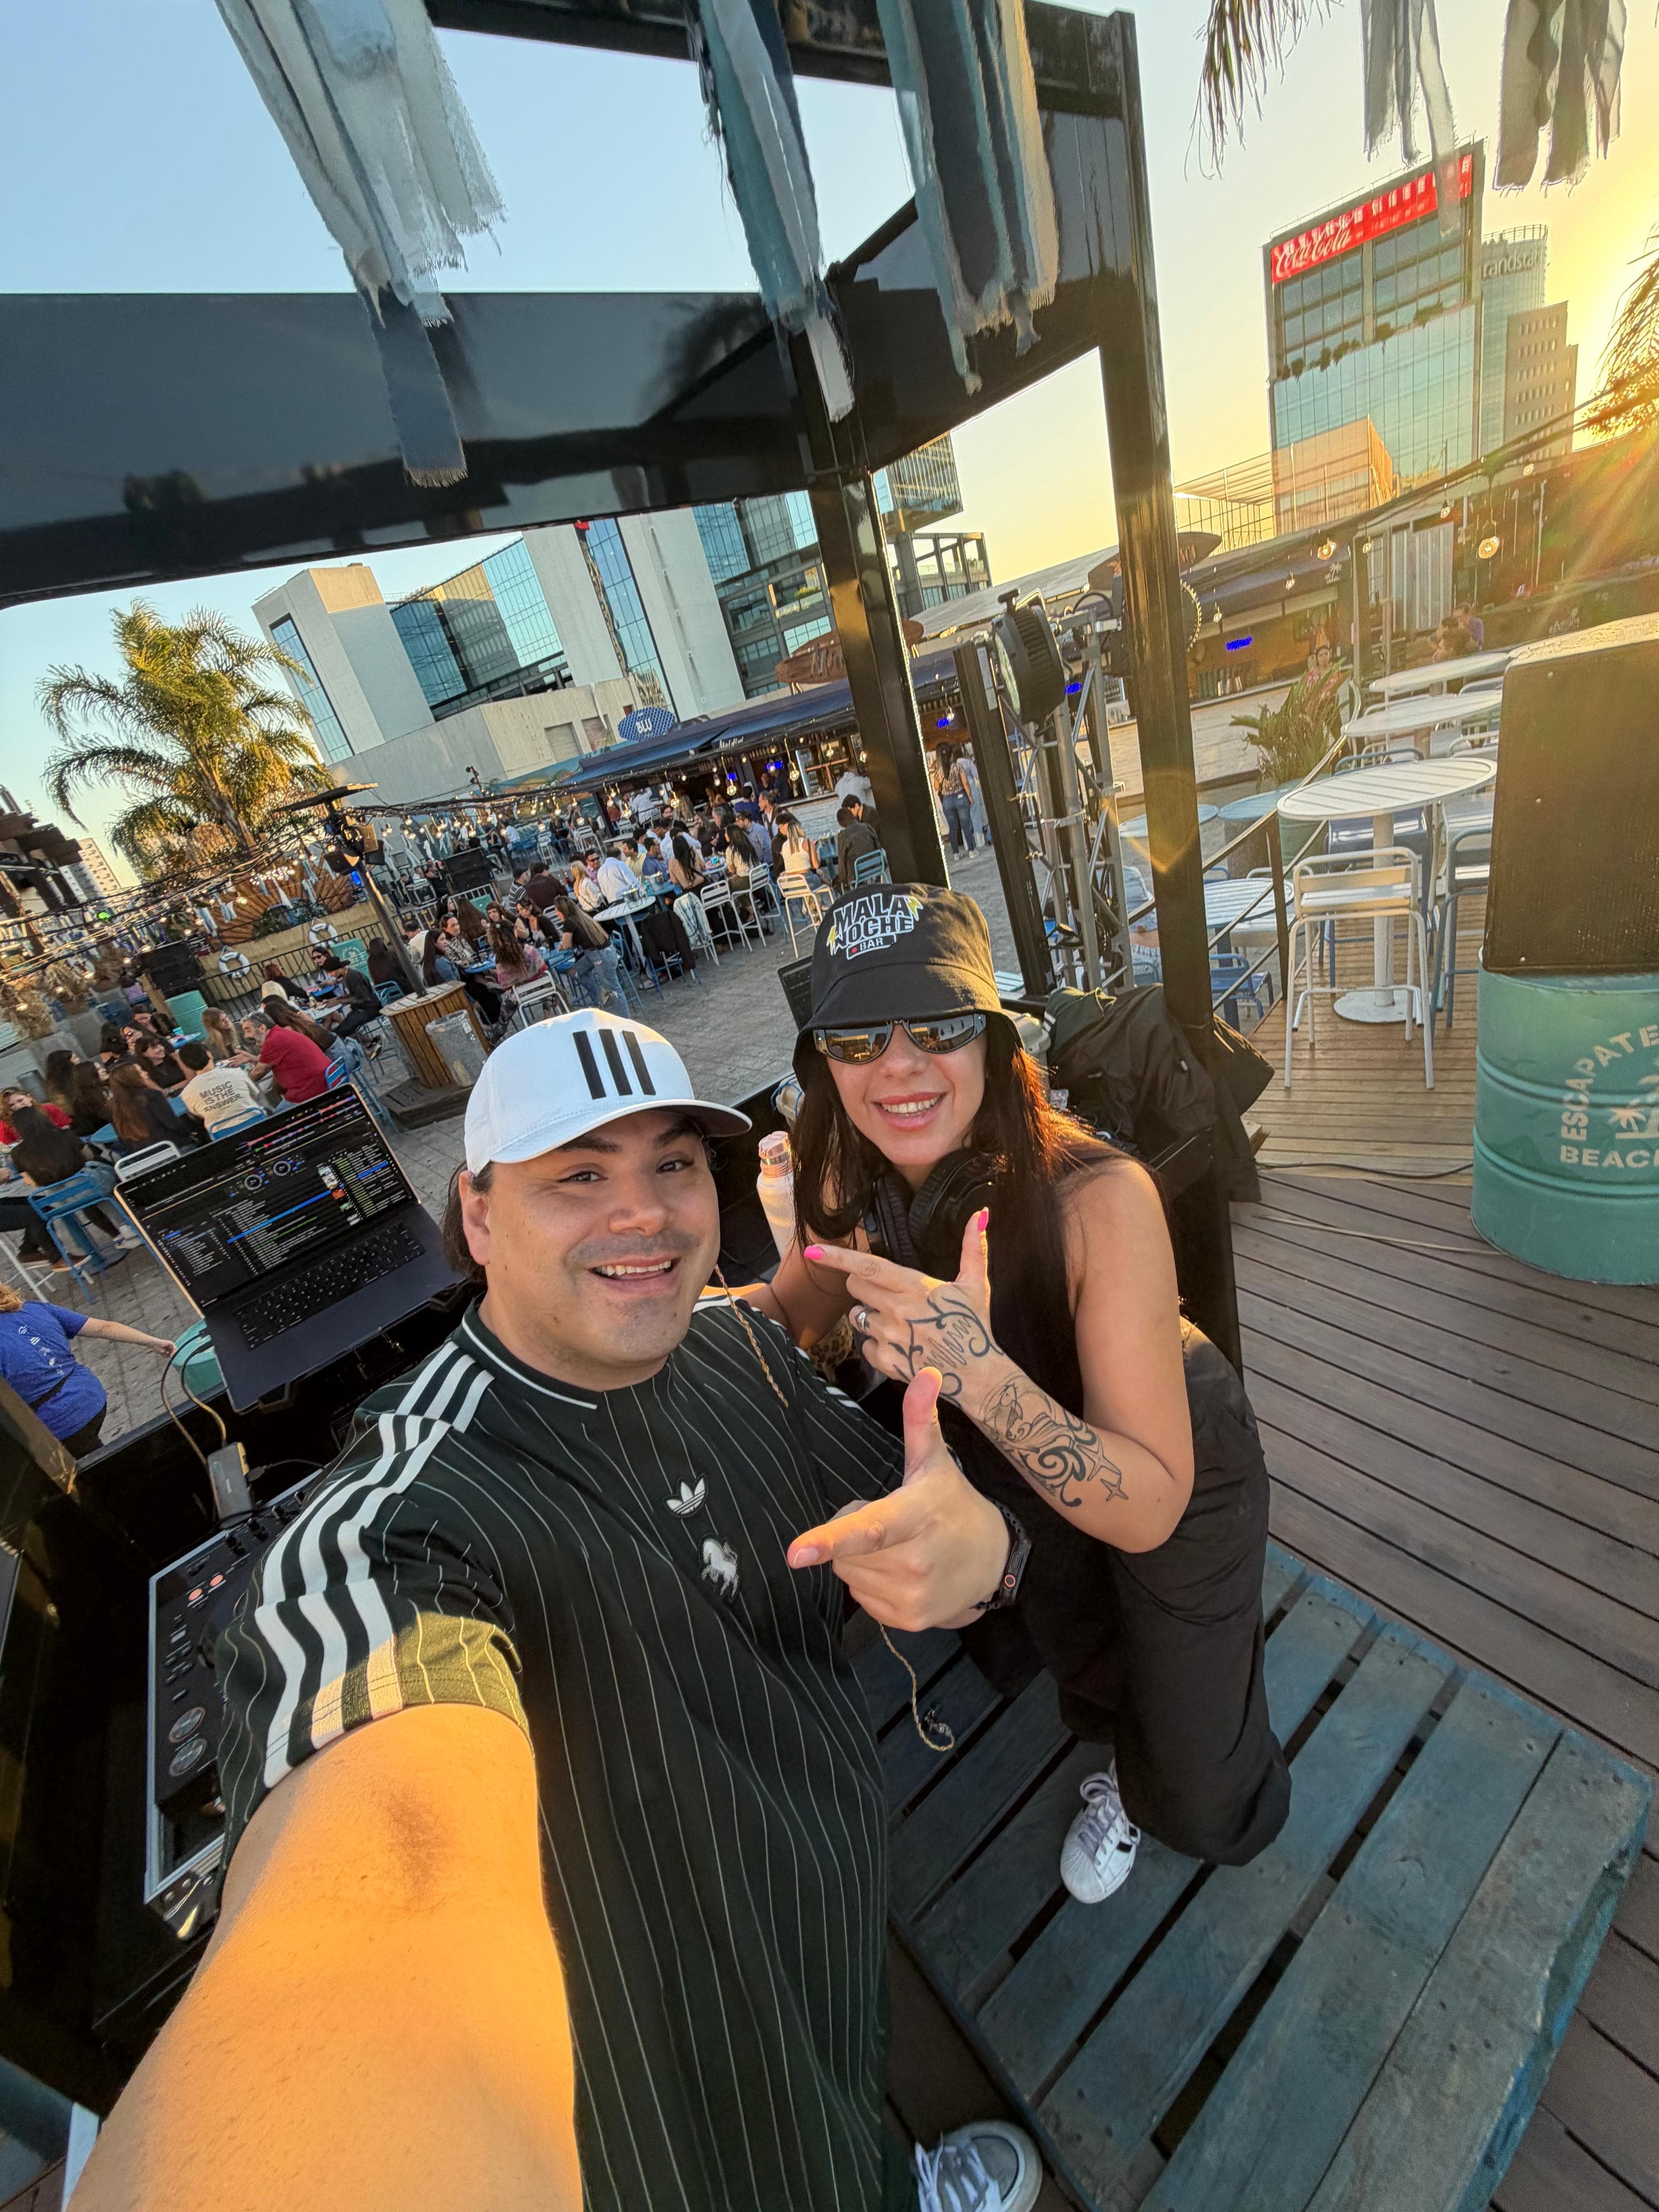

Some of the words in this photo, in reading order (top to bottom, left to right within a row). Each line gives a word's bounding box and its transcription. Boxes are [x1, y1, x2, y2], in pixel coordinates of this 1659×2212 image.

[636, 717, 652, 734] BLU
[833, 893, 913, 934] MALA
[834, 916, 914, 955] NOCHE
[860, 937, 884, 951] BAR
[199, 1080, 232, 1099] MUSIC
[1561, 1024, 1659, 1142] ESCAPATE
[204, 1096, 215, 1105] IS
[214, 1088, 235, 1101] THE
